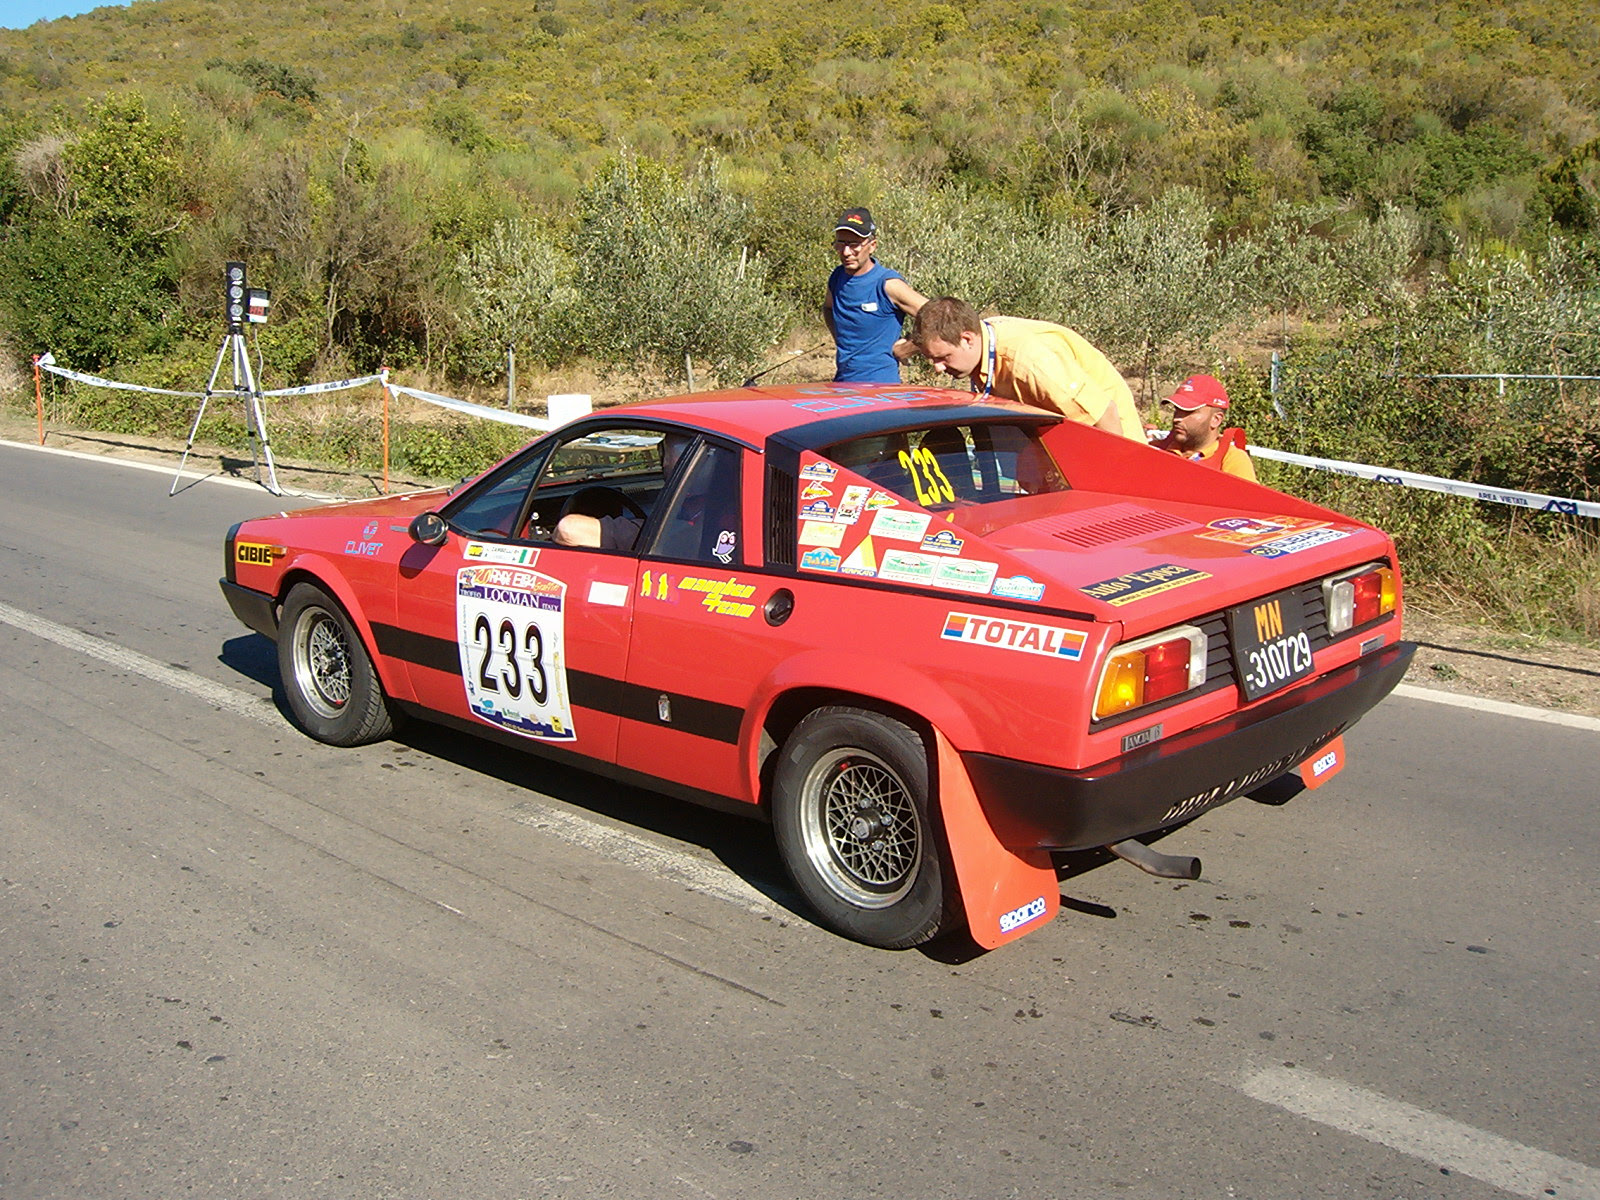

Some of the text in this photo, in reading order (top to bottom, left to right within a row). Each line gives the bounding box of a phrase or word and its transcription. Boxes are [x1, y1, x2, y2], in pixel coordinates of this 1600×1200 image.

[898, 447, 955, 507] 233
[1478, 492, 1529, 506] AREA VIETATA
[484, 587, 540, 609] LOCMAN
[1078, 581, 1132, 599] Auto
[970, 618, 1057, 653] TOTAL
[1254, 600, 1283, 643] MN
[473, 612, 549, 706] 233
[999, 896, 1046, 932] sparco
